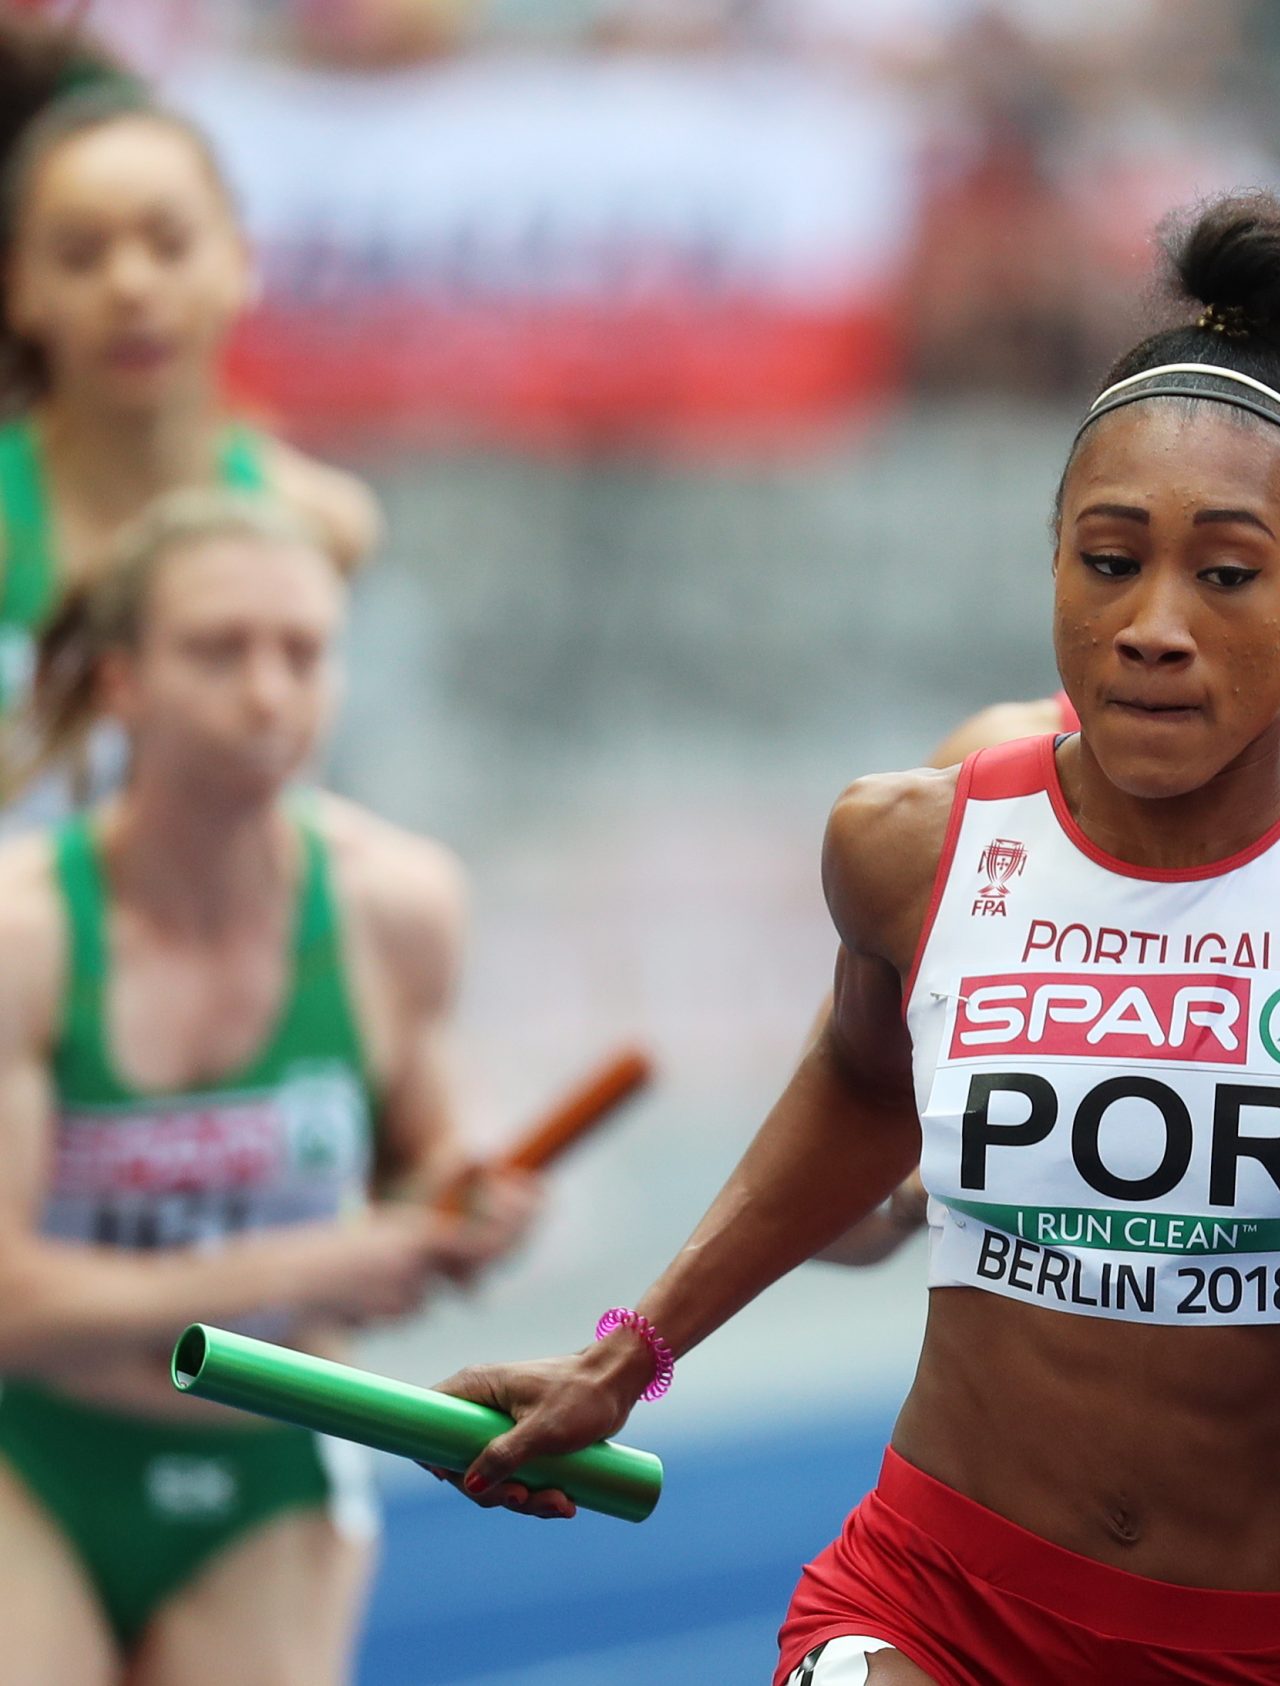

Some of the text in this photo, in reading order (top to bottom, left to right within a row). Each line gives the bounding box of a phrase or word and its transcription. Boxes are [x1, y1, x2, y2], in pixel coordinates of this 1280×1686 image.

[971, 899, 1007, 917] FPA
[1021, 919, 1270, 969] PORTUGAL
[960, 983, 1241, 1052] SPAR
[1018, 1211, 1025, 1238] I
[1037, 1213, 1112, 1245] RUN
[976, 1230, 1156, 1313] BERLIN
